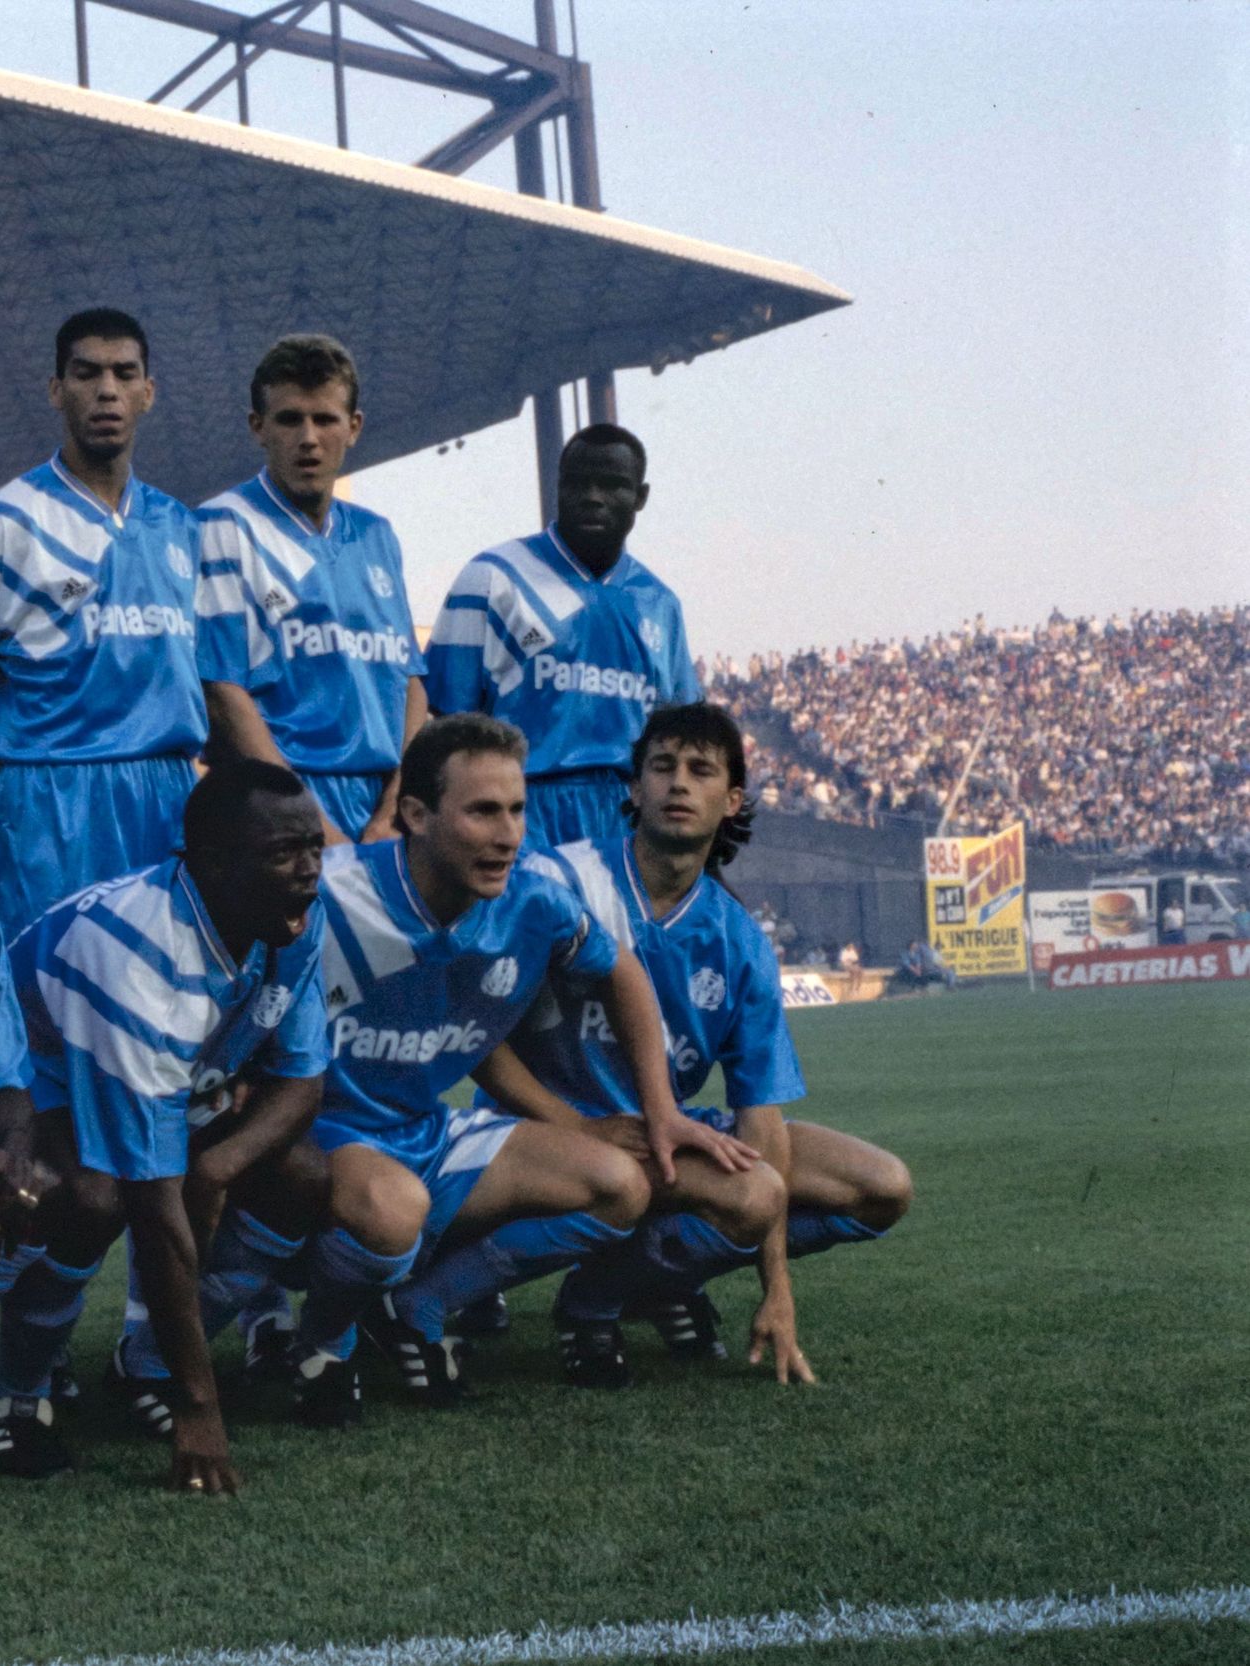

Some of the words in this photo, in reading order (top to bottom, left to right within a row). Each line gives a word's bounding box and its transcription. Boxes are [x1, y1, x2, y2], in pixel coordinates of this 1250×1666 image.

[928, 843, 960, 874] 98.9
[967, 829, 1021, 908] FUN
[1052, 954, 1219, 987] CAFETERIAS
